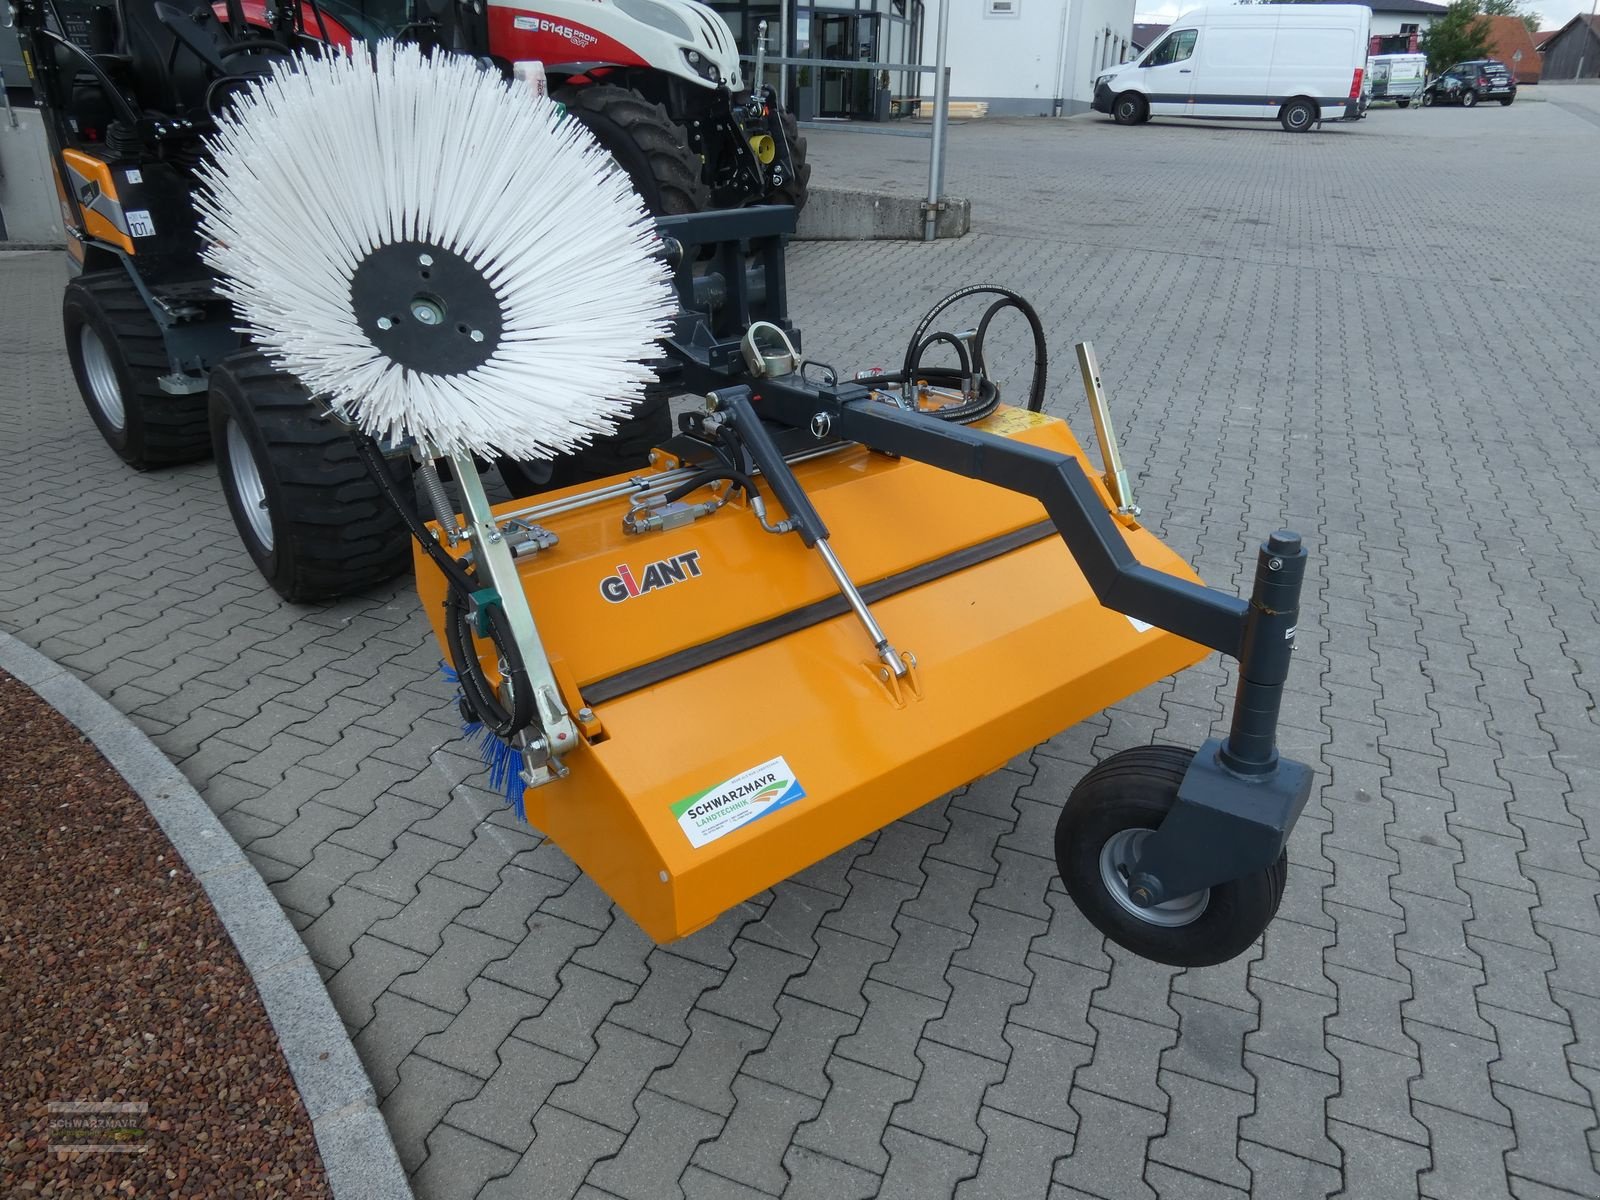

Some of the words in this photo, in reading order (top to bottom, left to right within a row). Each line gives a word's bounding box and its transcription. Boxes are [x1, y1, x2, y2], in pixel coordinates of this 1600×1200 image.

[540, 20, 573, 39] 6145
[573, 30, 598, 44] PROFI
[130, 222, 148, 236] 101
[687, 773, 777, 819] SCHWARZMAYR
[695, 799, 750, 827] LANDTECHNIK
